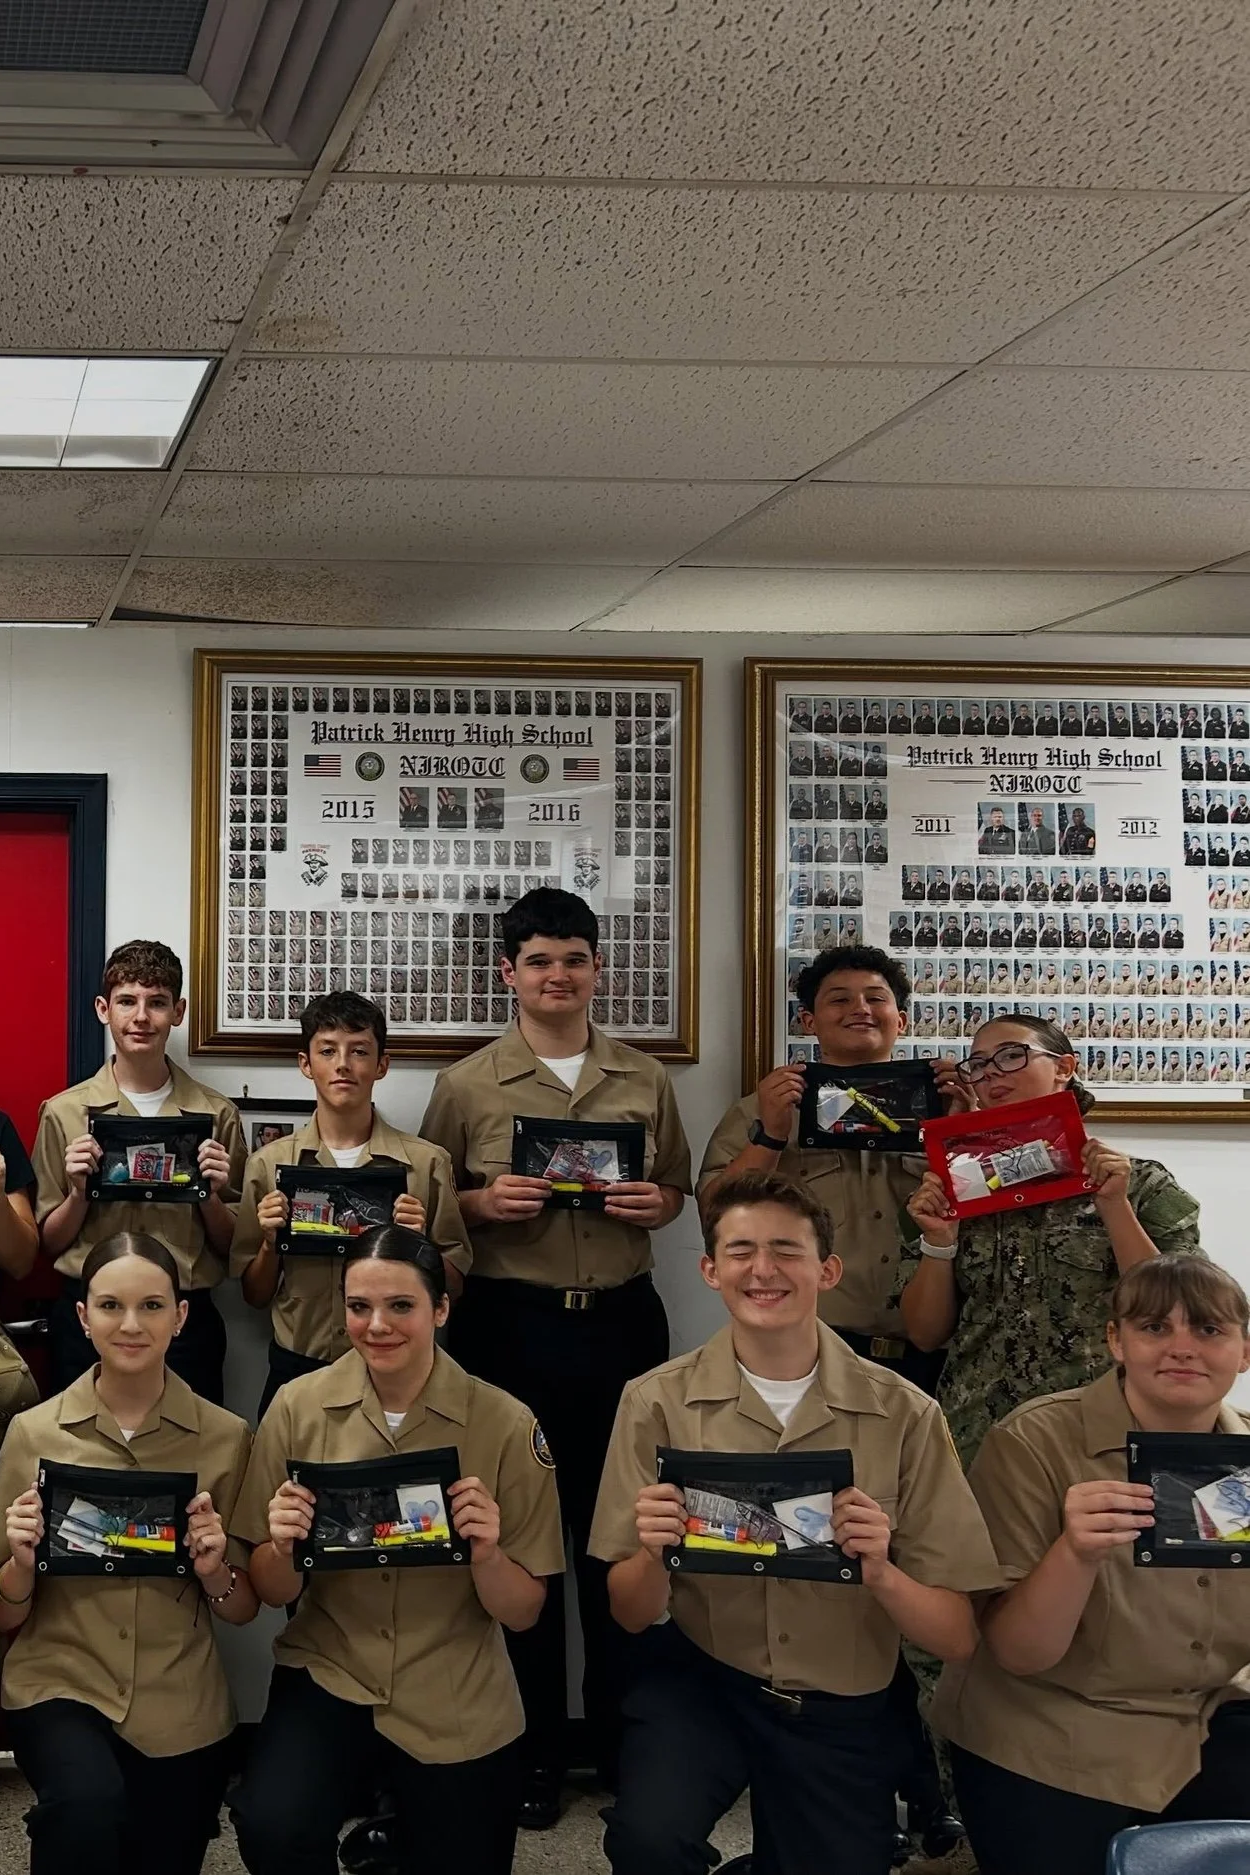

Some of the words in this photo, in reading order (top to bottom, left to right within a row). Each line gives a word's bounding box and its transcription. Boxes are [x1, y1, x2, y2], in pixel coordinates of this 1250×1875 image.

[311, 721, 385, 744] Patrick
[391, 722, 454, 747] Henry
[462, 722, 514, 748] High
[521, 723, 593, 749] School
[400, 755, 506, 777] NJROTC
[907, 746, 974, 768] Patrick
[980, 746, 1038, 770] Henry
[1044, 747, 1091, 771] High
[1097, 748, 1162, 771] School
[989, 774, 1083, 794] NJROTC
[322, 800, 375, 819] 2015
[529, 803, 581, 822] 2016
[914, 818, 952, 833] 2011
[1120, 821, 1158, 835] 2012
